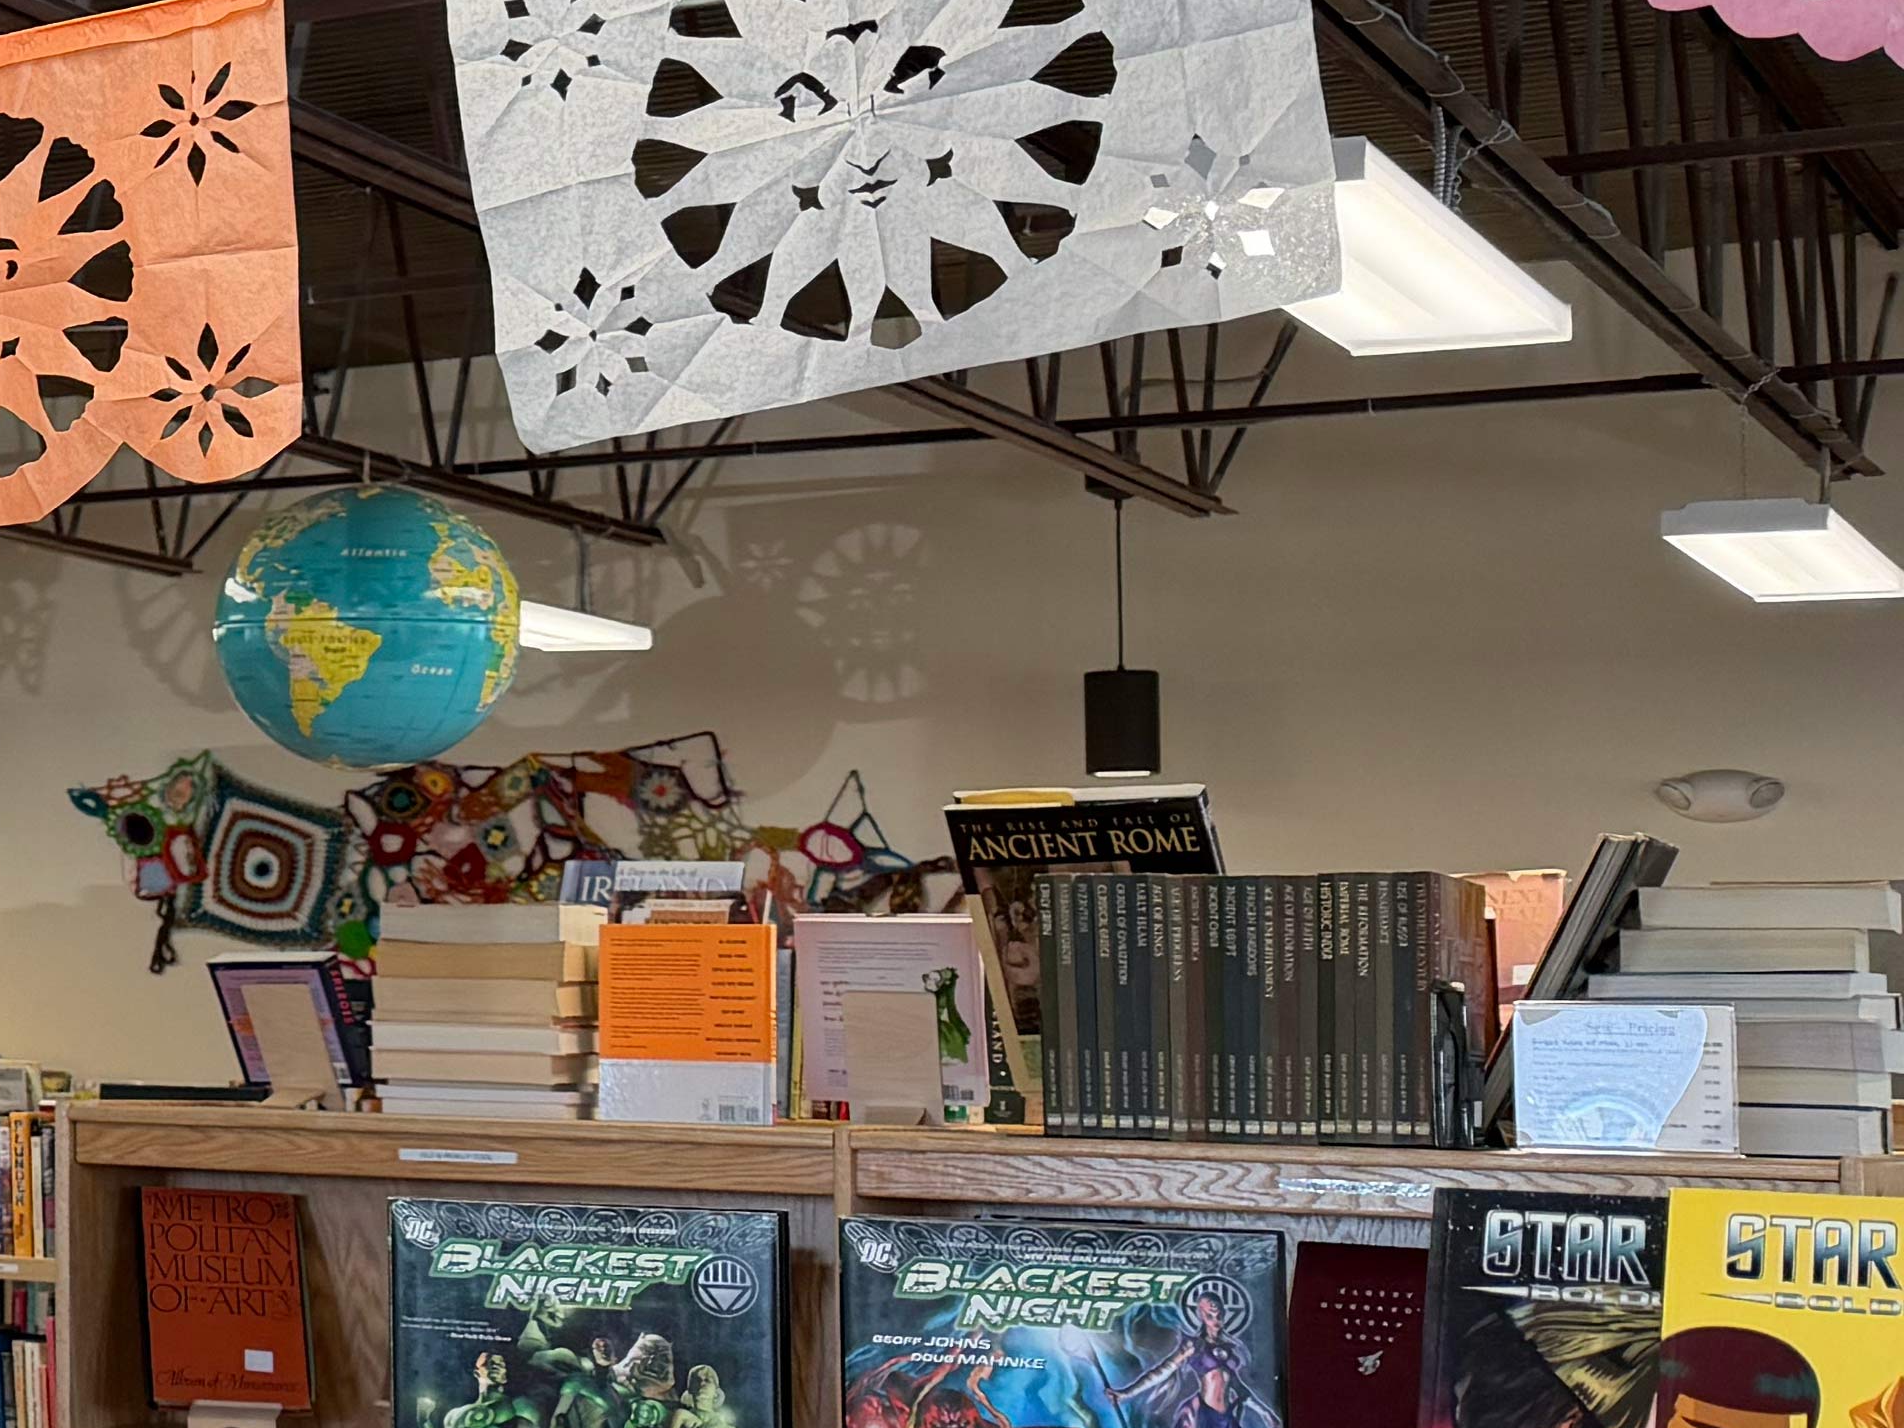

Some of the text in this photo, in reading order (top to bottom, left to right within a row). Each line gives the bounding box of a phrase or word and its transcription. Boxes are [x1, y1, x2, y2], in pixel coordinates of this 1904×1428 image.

[411, 663, 453, 676] Ocean
[969, 827, 1200, 861] ANCIENT ROME
[580, 874, 729, 902] IRELAND
[150, 1194, 276, 1226] METRO
[150, 1223, 292, 1255] POLITAN
[407, 1218, 435, 1241] DC
[436, 1245, 704, 1280] BLACKEST
[860, 1242, 892, 1264] DC
[1482, 1208, 1651, 1286] STAR
[1725, 1212, 1904, 1290] STAR
[149, 1253, 295, 1288] MUSEUM
[900, 1261, 1190, 1302] BLACKEST
[491, 1273, 640, 1307] NIGHT
[963, 1293, 1125, 1327] NIGHT
[924, 1336, 992, 1351] JOHNS
[910, 1352, 1045, 1370] DOUG MAHNKE
